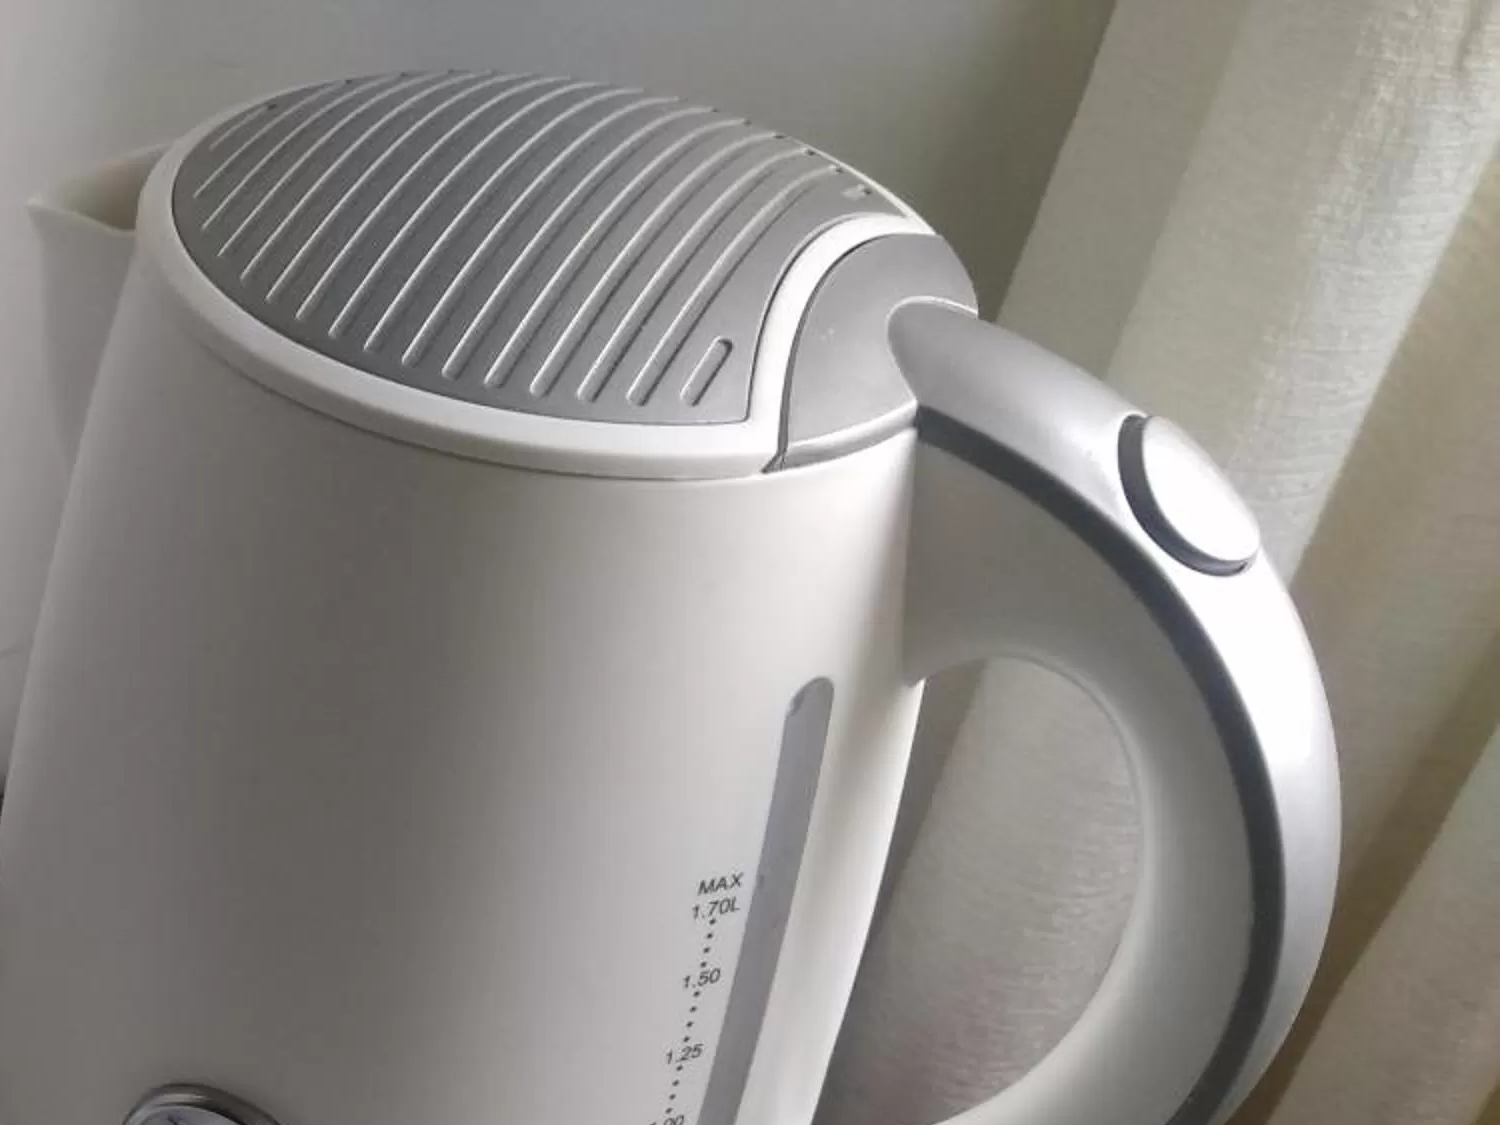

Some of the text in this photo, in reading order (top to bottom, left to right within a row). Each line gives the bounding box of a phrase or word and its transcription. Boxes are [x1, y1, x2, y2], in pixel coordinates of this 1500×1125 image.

[697, 872, 744, 896] MAX
[691, 897, 741, 920] 1.70L
[682, 968, 722, 989] 1.50
[665, 1043, 704, 1065] 1.25
